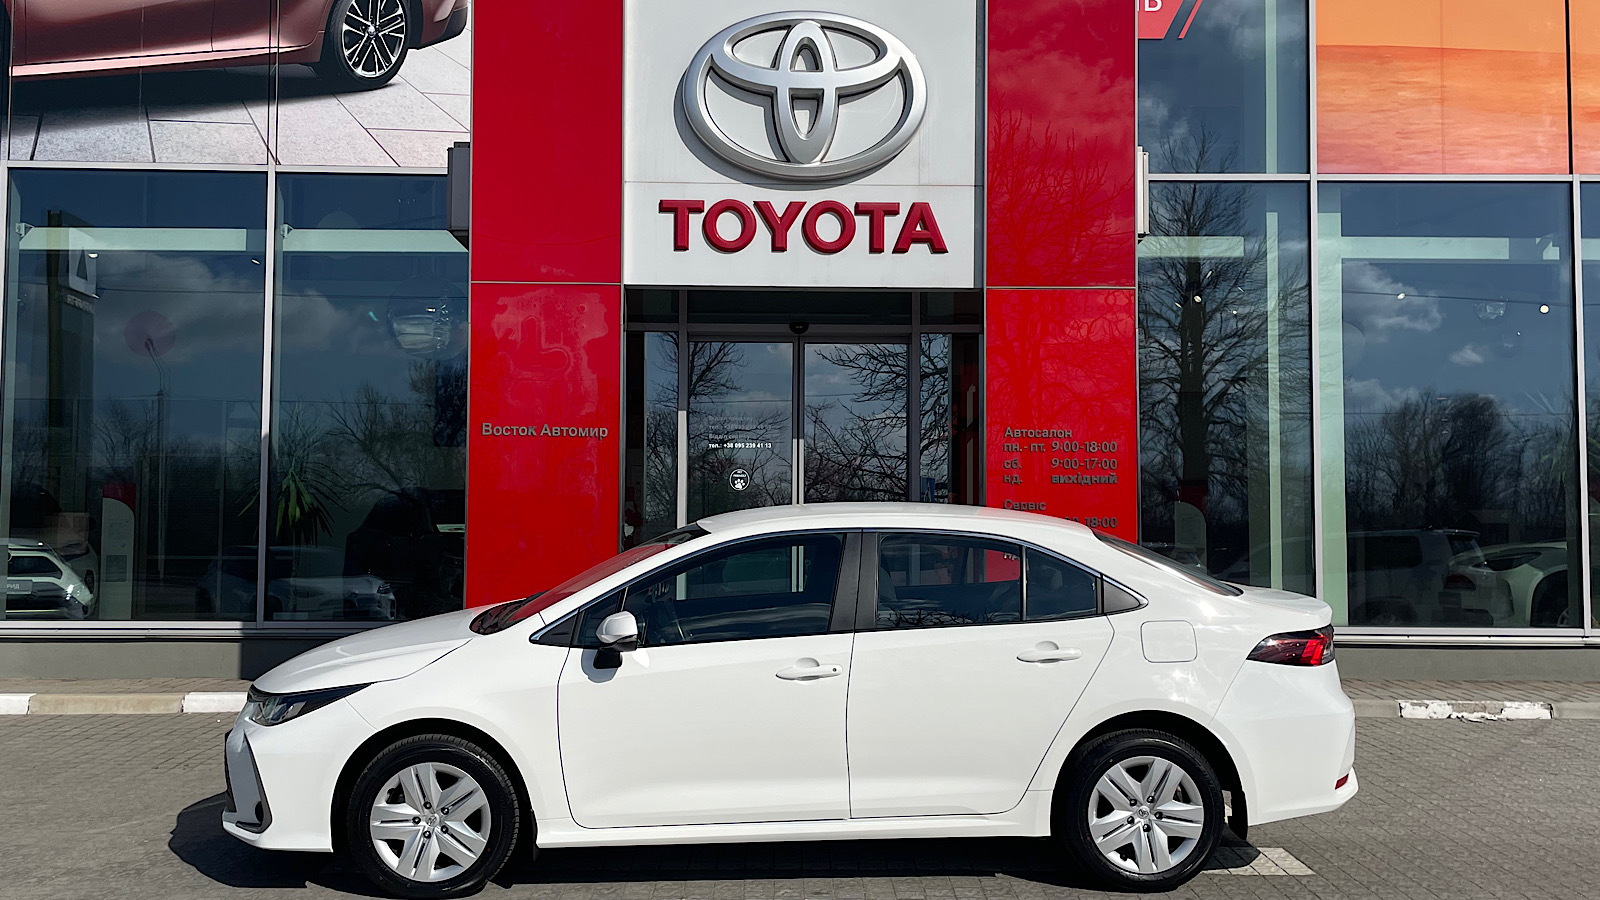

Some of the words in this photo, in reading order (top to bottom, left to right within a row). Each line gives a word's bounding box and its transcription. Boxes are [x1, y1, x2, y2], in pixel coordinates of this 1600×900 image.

[659, 198, 949, 255] TOYOTA
[482, 422, 537, 436] Восток
[540, 424, 608, 441] Автомир
[1004, 427, 1073, 438] Автосалон
[1051, 441, 1118, 453] 9:00-18:00
[1003, 458, 1023, 469] сб.
[1051, 458, 1118, 470] 9:00-17:00
[1003, 474, 1023, 485] нд.
[1051, 472, 1118, 485] вихідний
